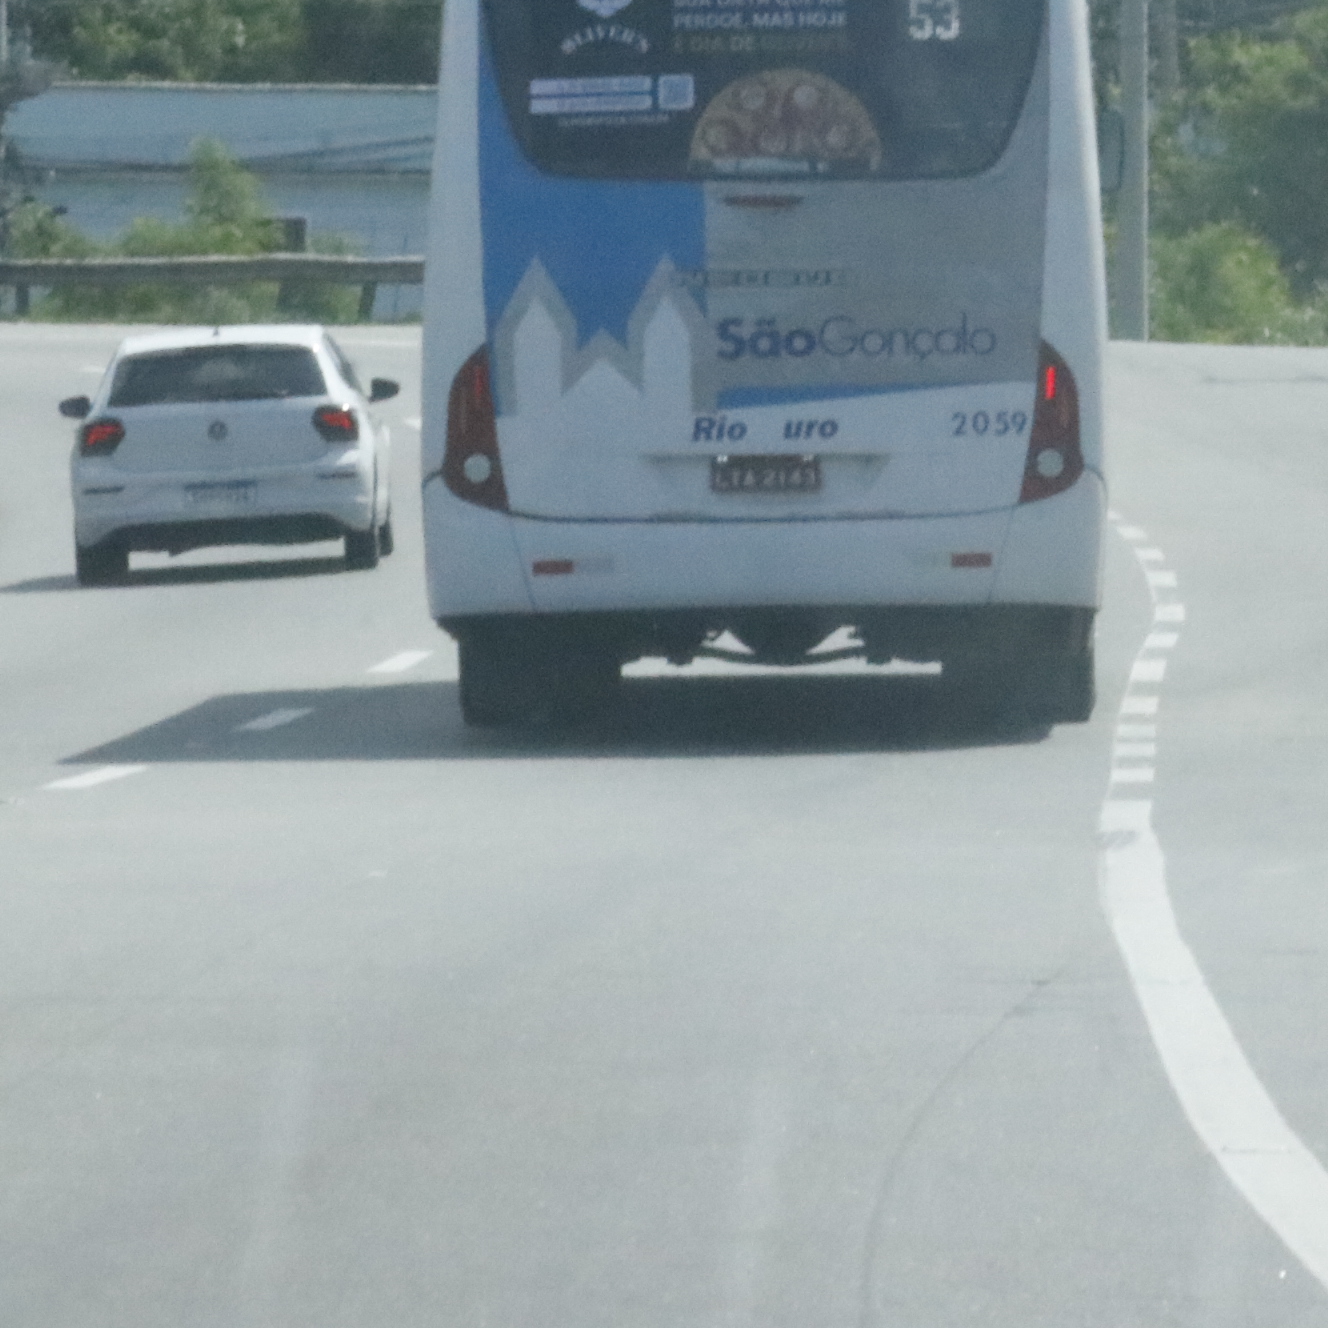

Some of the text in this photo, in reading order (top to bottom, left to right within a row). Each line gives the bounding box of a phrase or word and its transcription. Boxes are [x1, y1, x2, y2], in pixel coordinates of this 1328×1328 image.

[752, 11, 793, 27] MAS
[798, 10, 847, 27] HOJE
[730, 34, 755, 52] DE
[691, 416, 747, 442] Rio
[951, 410, 1027, 436] 2059
